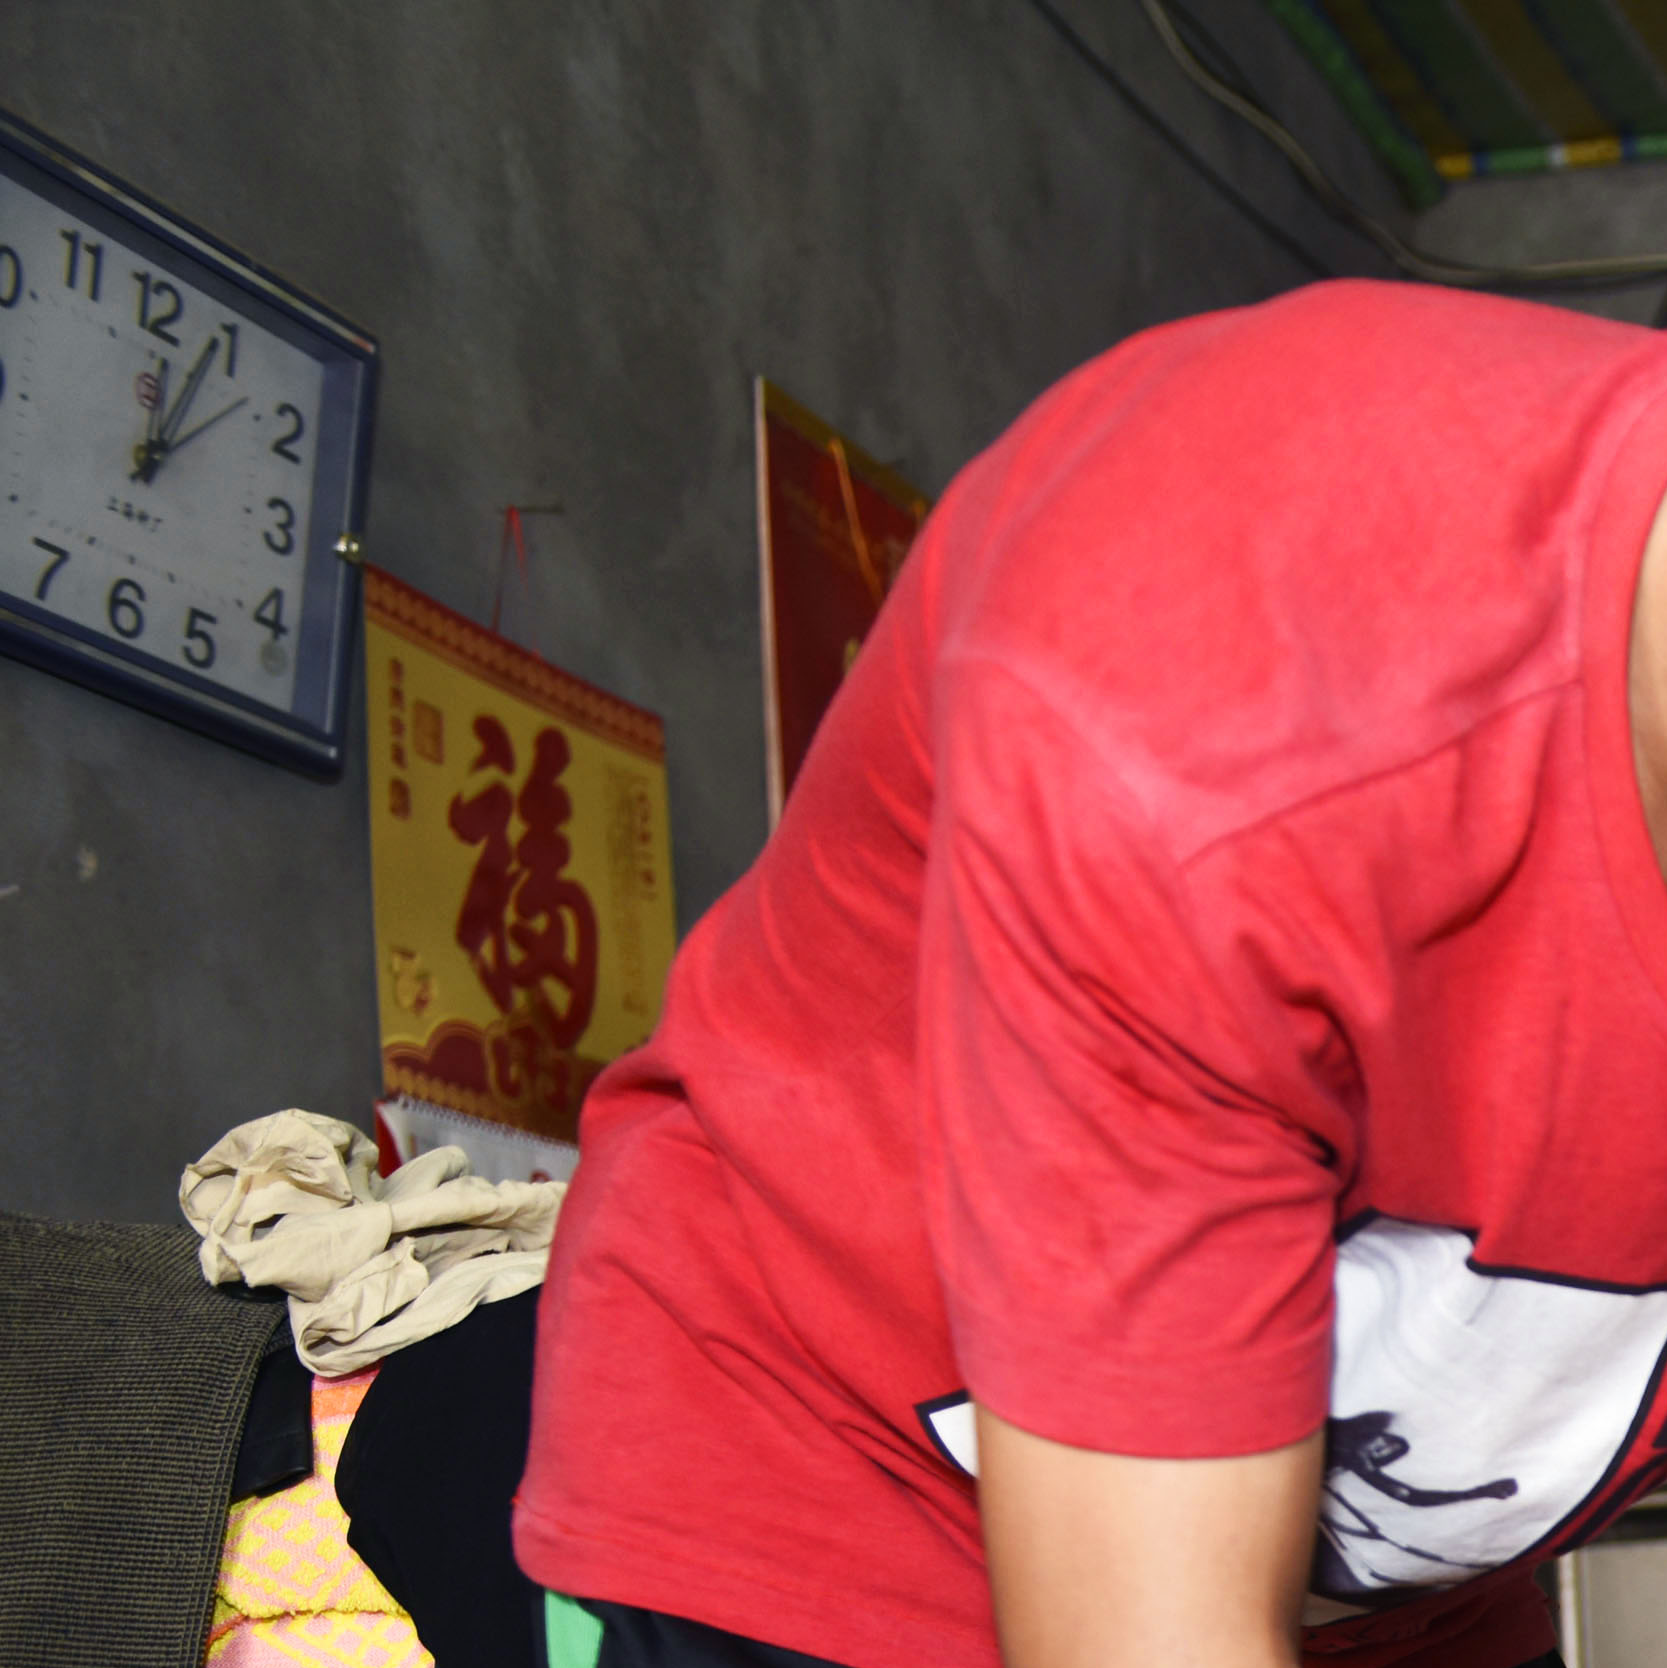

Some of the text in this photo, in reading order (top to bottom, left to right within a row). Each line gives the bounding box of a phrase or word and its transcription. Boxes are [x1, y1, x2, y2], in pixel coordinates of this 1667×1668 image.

[0, 244, 22, 309] 0
[59, 228, 102, 301] 11
[132, 270, 184, 347] 12
[220, 322, 238, 378] 1
[271, 402, 304, 464] 2
[263, 497, 295, 556] 3
[31, 536, 70, 600] 7
[108, 577, 146, 639] 6
[181, 606, 218, 669] 5
[253, 587, 288, 640] 4
[448, 716, 597, 1052] 福
